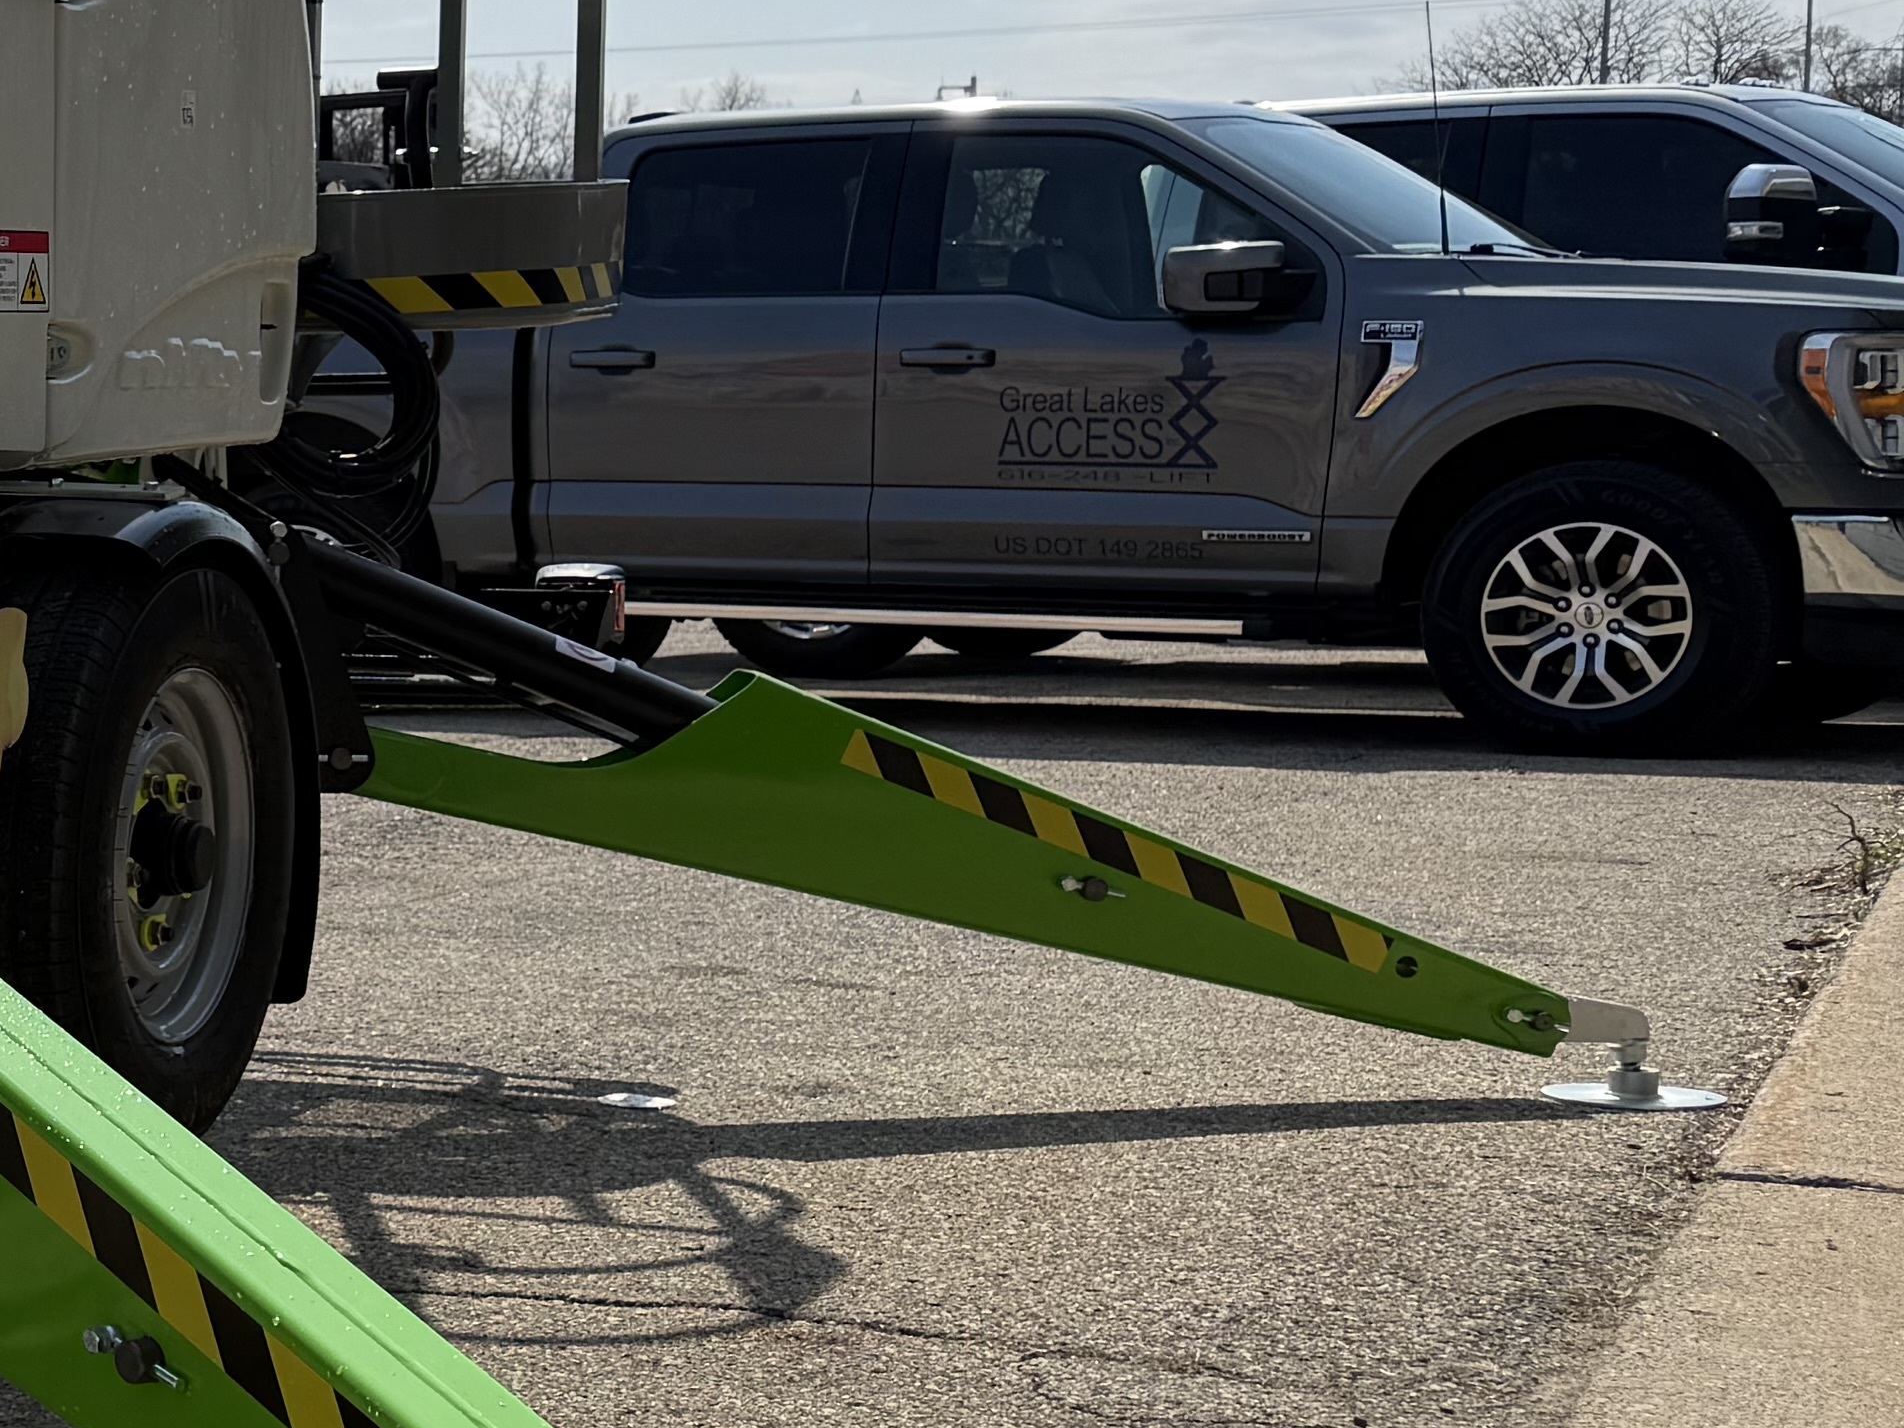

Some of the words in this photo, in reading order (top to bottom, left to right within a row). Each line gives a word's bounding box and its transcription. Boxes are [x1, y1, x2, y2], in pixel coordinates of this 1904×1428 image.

[999, 386, 1072, 413] Great
[1083, 386, 1164, 414] Lakes
[998, 416, 1164, 460] ACCESS
[994, 535, 1027, 555] US
[1035, 537, 1089, 556] DOT
[1097, 538, 1138, 558] 149
[1146, 540, 1205, 561] 2865
[1206, 531, 1306, 541] POWERBOOST
